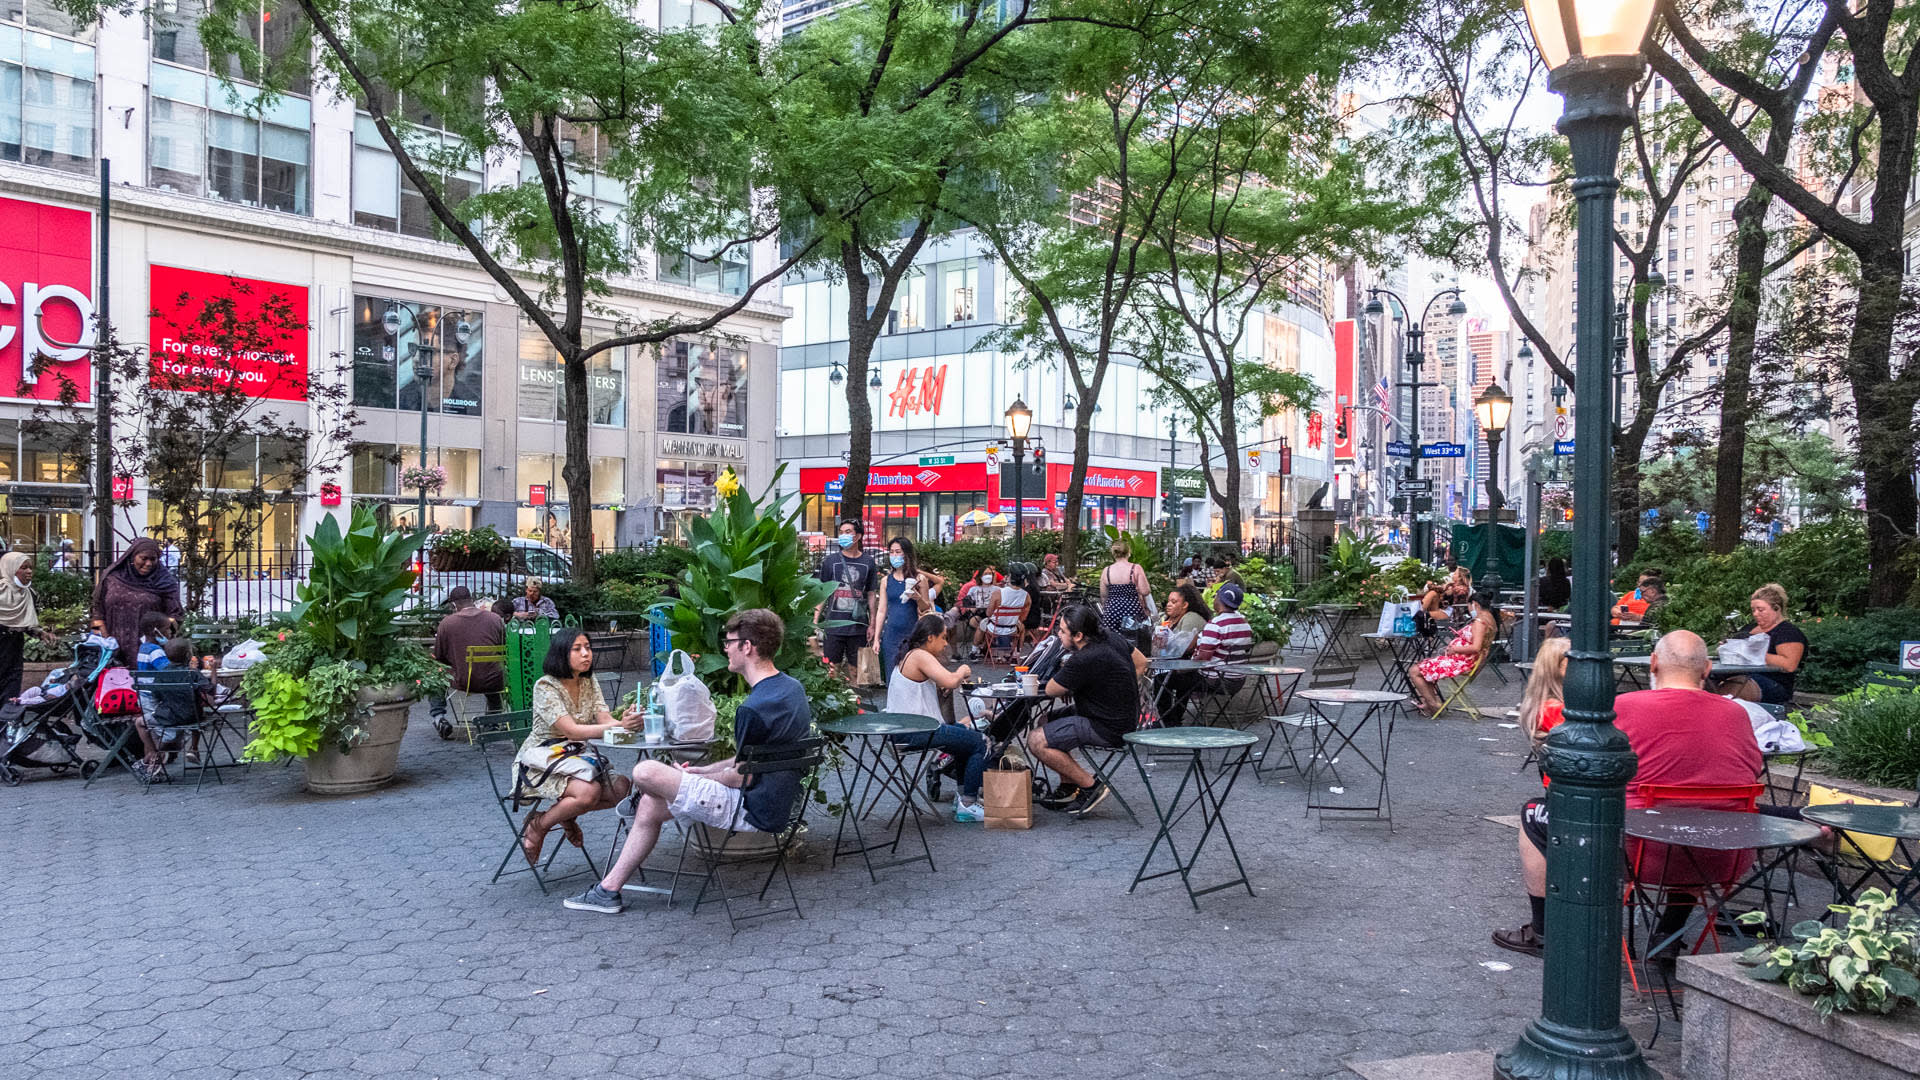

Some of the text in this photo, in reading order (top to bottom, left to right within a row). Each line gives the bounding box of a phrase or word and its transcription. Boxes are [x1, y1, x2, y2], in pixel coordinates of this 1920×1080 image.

[162, 338, 188, 353] For
[162, 360, 189, 375] For
[889, 364, 948, 418] H&M
[443, 398, 478, 407] HOLBROOK
[720, 443, 744, 458] MALL
[1425, 447, 1440, 455] West
[1454, 447, 1462, 455] St
[1558, 445, 1575, 453] Wes
[873, 473, 913, 486] America
[1096, 475, 1126, 488] America
